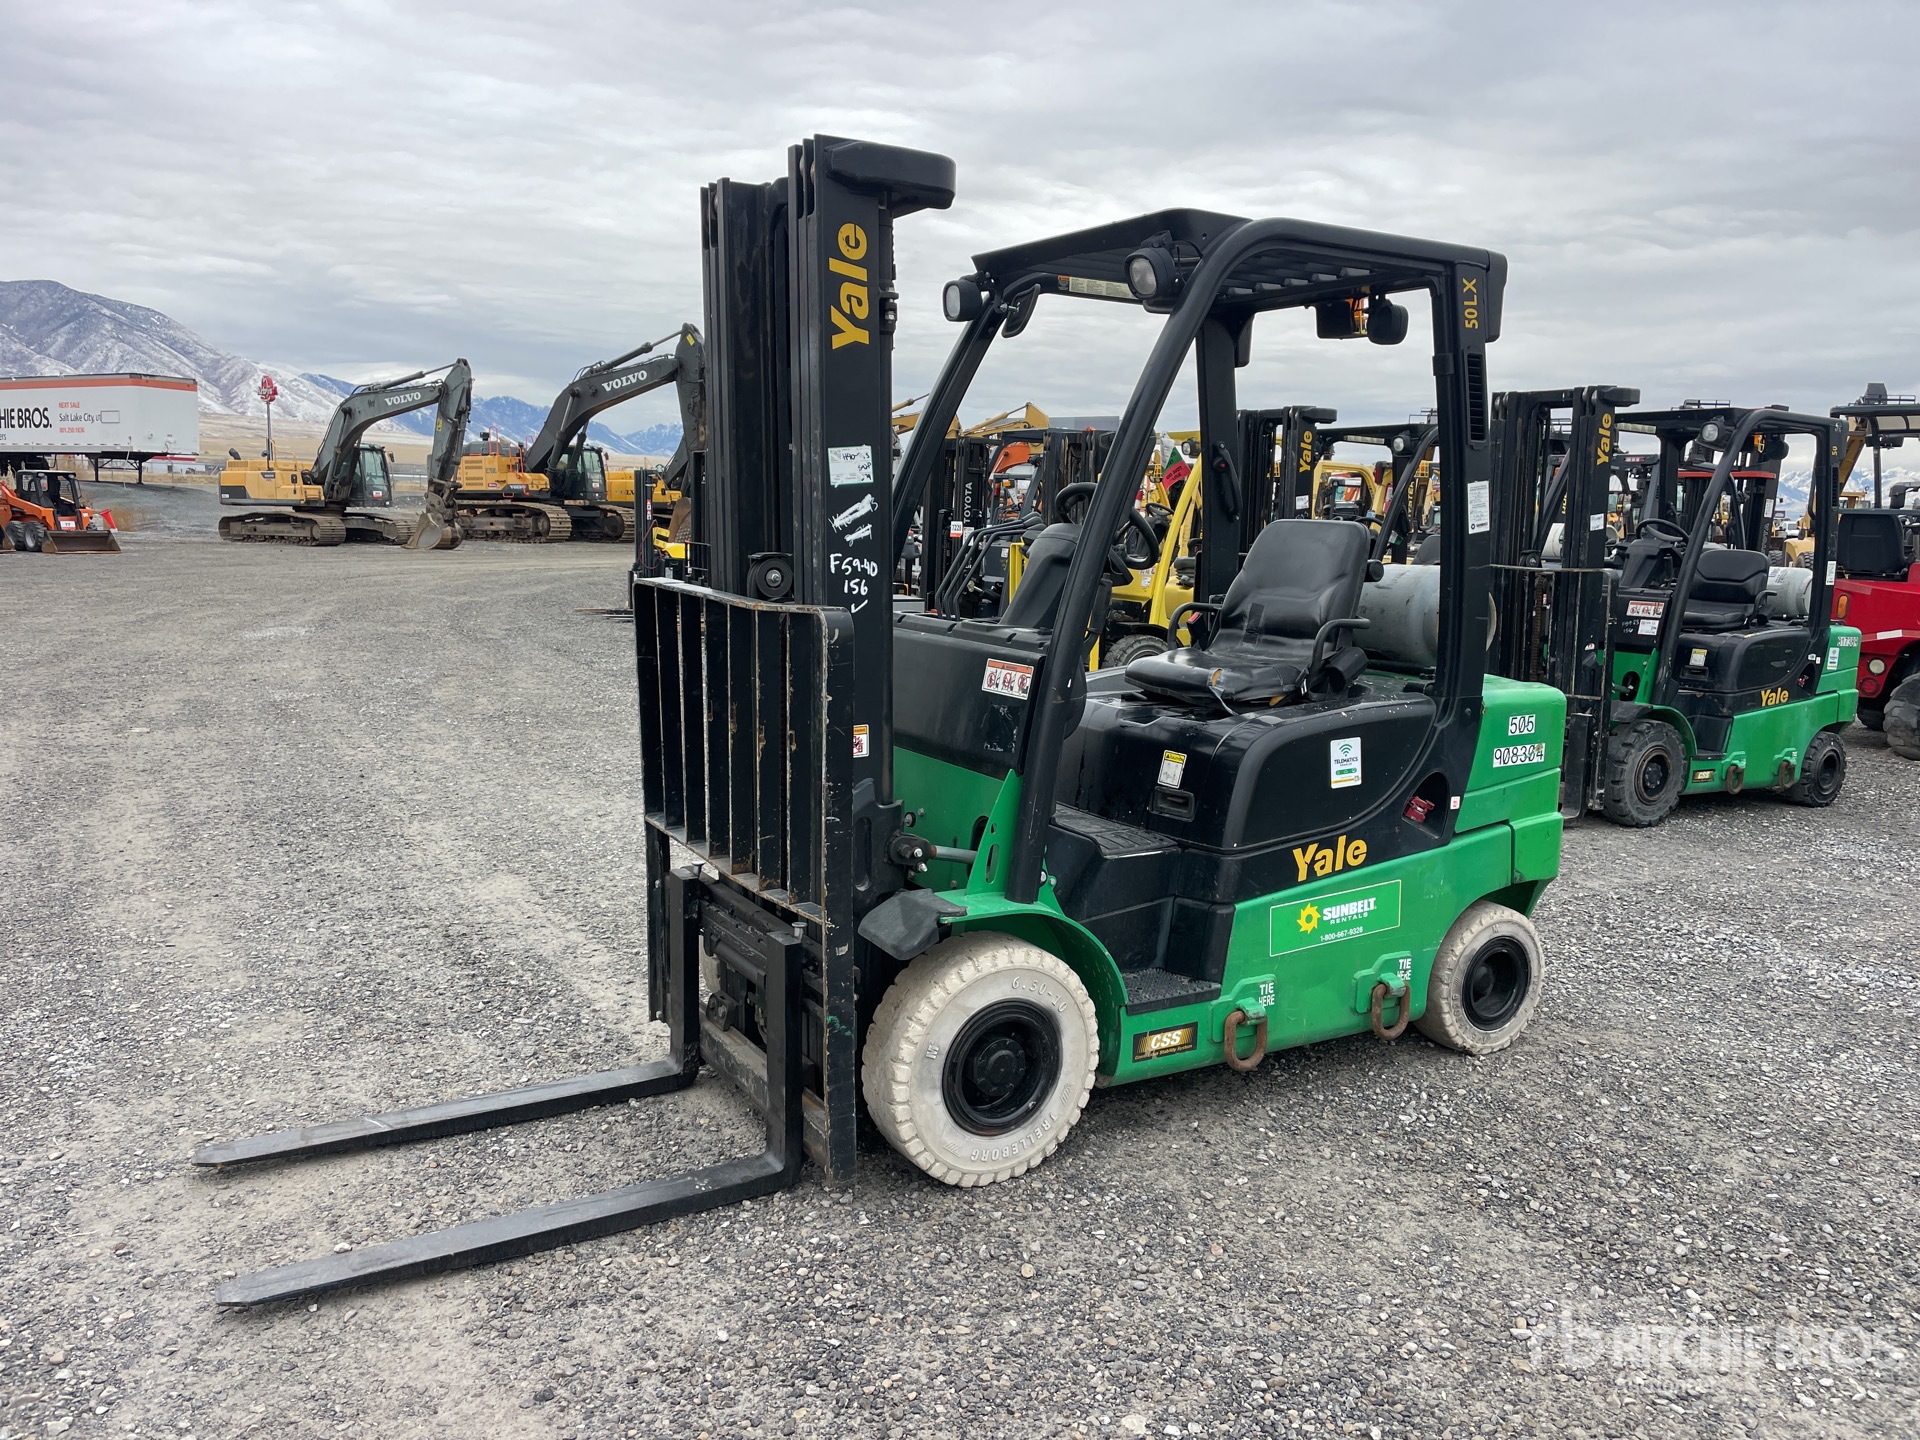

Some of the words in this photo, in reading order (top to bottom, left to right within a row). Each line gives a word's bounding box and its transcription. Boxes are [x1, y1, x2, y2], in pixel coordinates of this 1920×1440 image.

[828, 222, 870, 350] Yale
[1462, 277, 1479, 330] 50LX
[602, 370, 648, 392] VOLVO
[384, 391, 421, 406] VOLVO
[17, 407, 52, 428] BROS.
[59, 413, 69, 421] Salt
[70, 413, 82, 421] Lake
[1597, 413, 1612, 466] Yale
[1299, 430, 1313, 473] Yale
[963, 481, 973, 524] TOYOTA
[843, 579, 868, 596] 156
[1760, 687, 1789, 707] Yale
[1509, 715, 1535, 735] 505
[1333, 756, 1359, 765] TELEMATICS
[1292, 835, 1368, 882] Yale
[1322, 897, 1377, 921] SUNBELT
[1330, 911, 1369, 925] RENTALS
[1399, 958, 1412, 970] TIE
[1260, 982, 1275, 995] TIE
[1150, 1030, 1182, 1049] CSS
